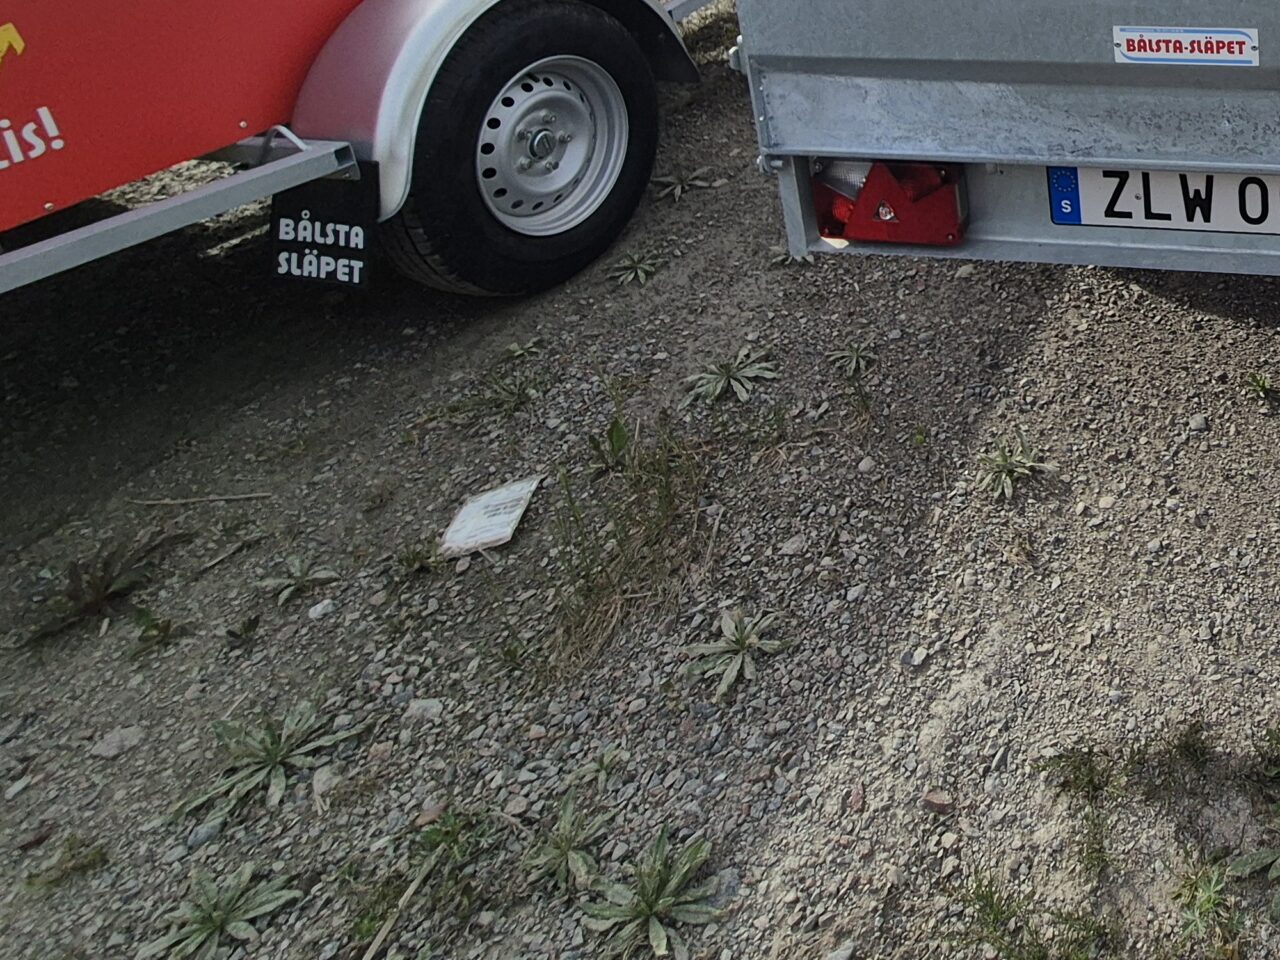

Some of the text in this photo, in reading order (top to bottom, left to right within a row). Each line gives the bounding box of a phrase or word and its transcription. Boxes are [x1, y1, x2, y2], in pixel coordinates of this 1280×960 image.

[1125, 34, 1246, 55] BÅLSTA-SLÄPET
[0, 106, 65, 170] is!
[1061, 199, 1072, 214] S
[1102, 169, 1214, 224] ZLW
[278, 209, 365, 249] BÅLSTA
[277, 248, 364, 284] SLÄPET
